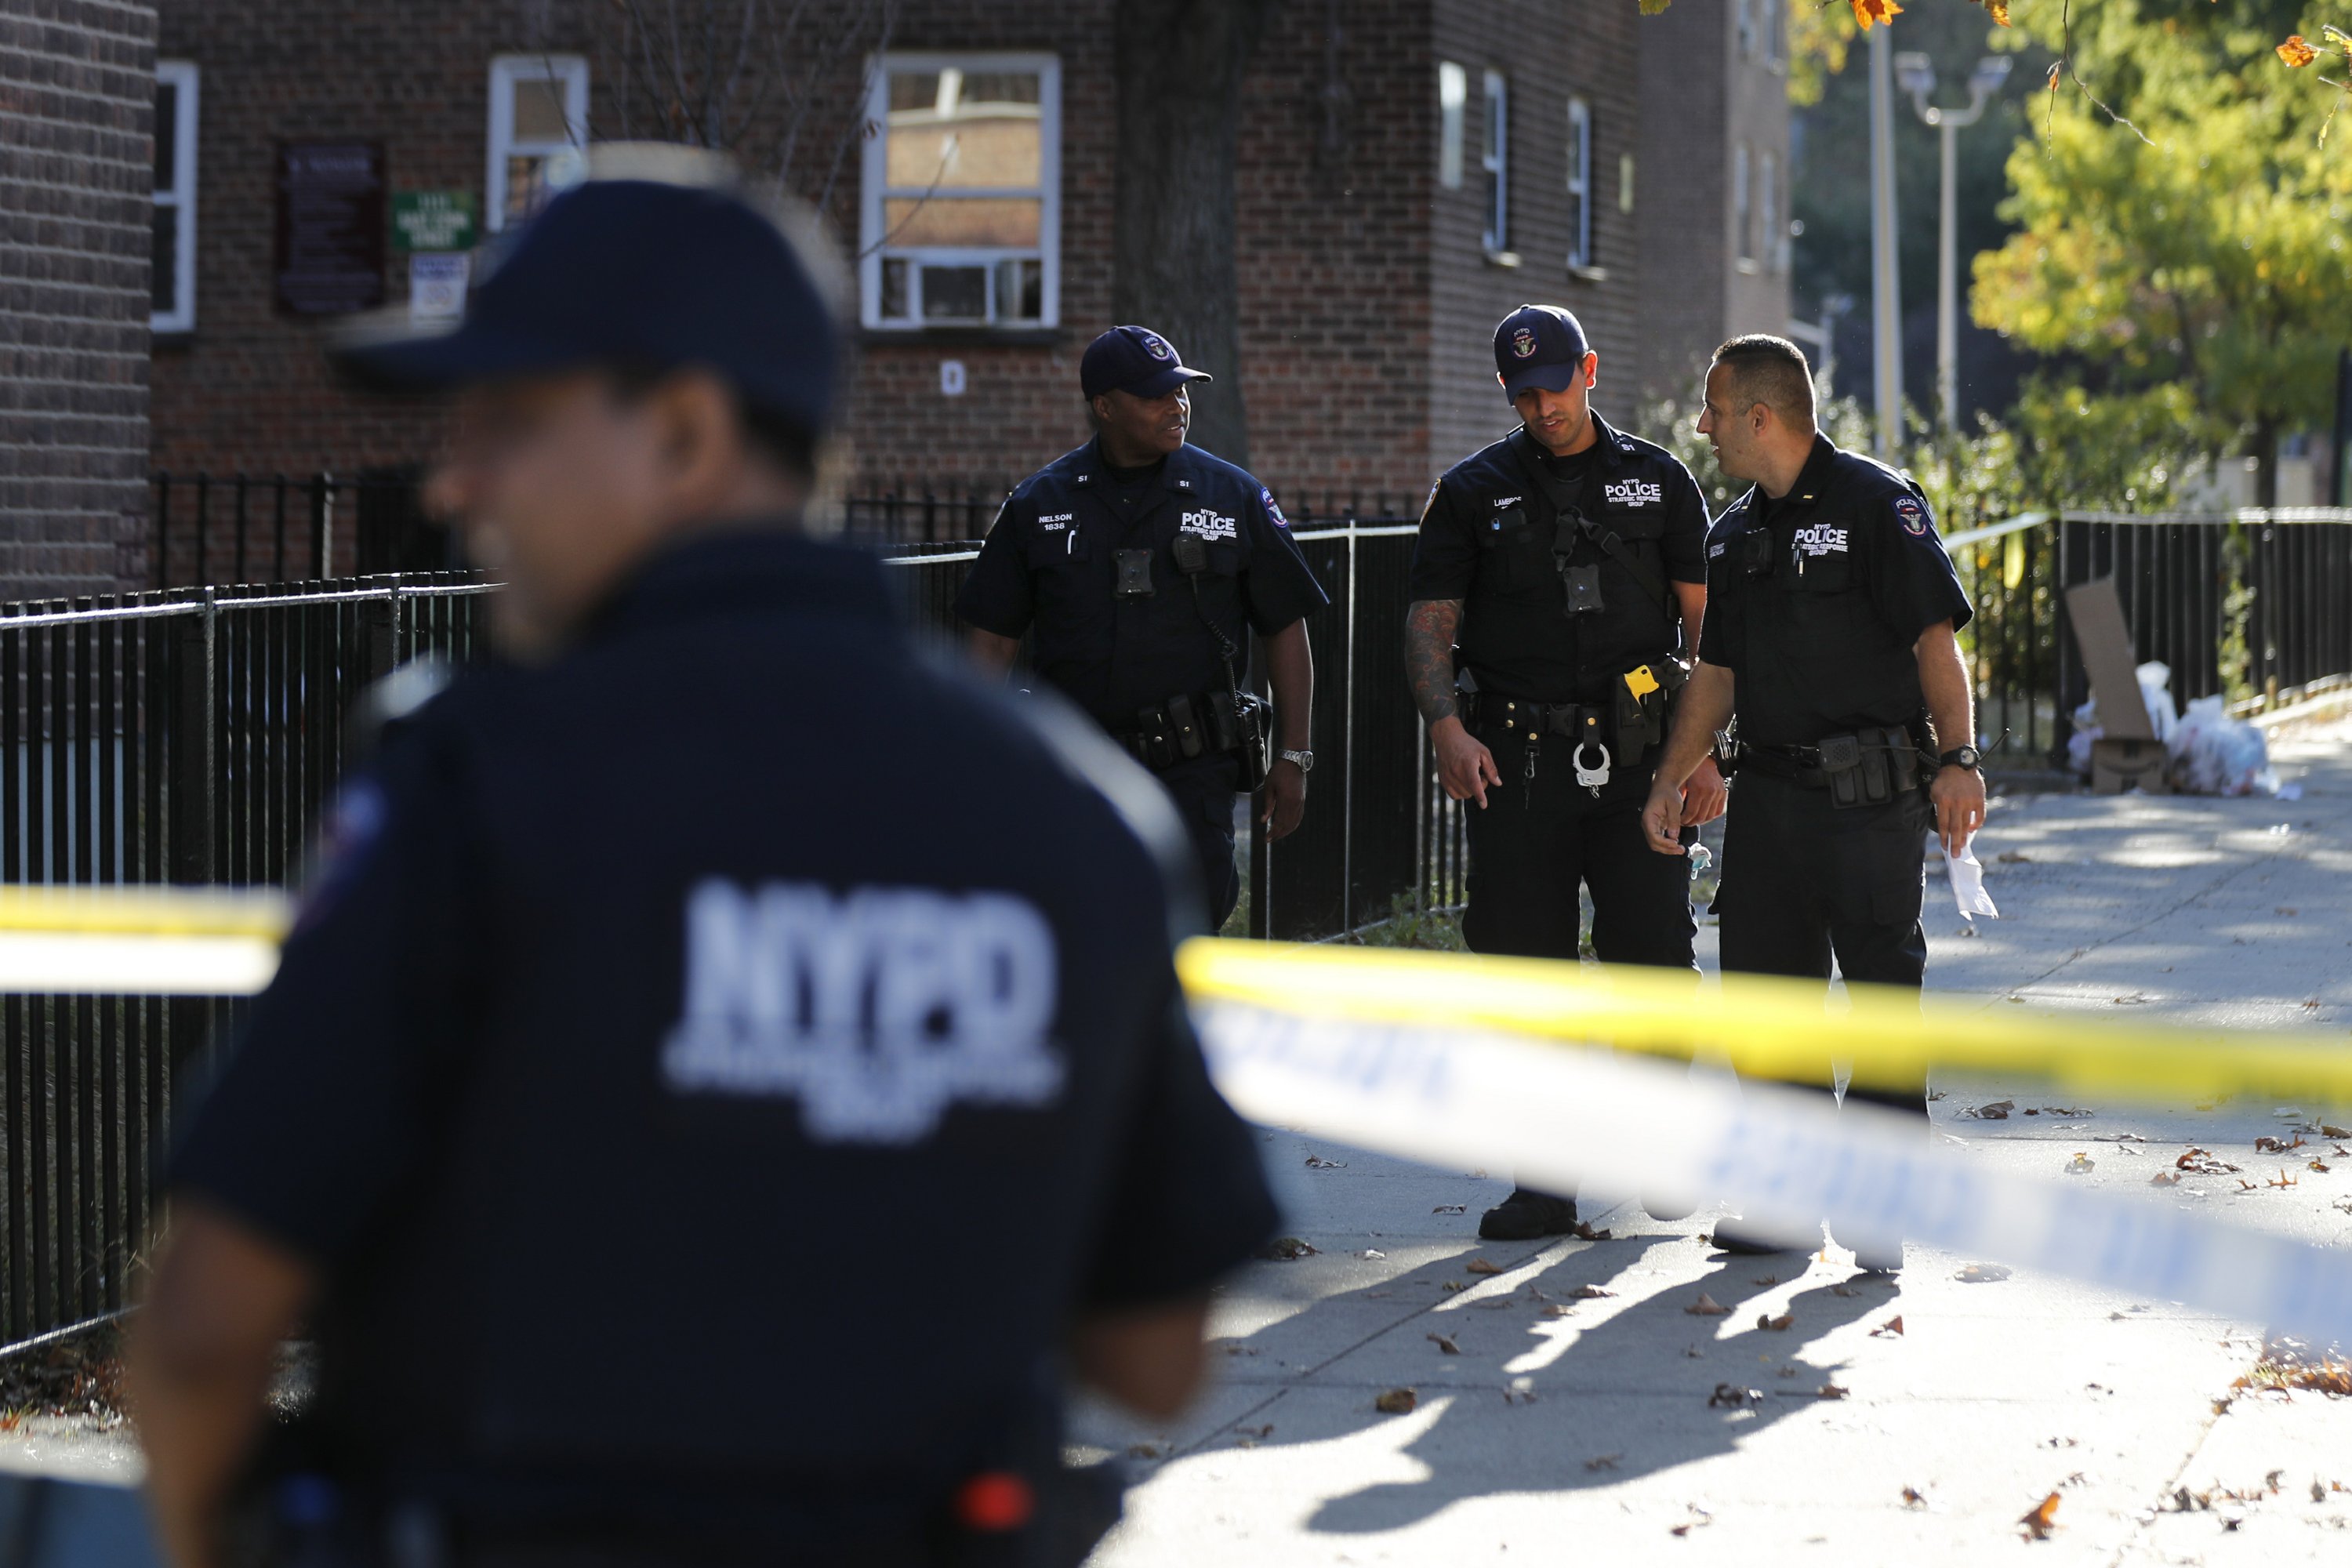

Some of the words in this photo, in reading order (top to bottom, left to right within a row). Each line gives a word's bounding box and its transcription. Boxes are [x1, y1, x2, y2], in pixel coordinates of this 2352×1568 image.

[1605, 484, 1661, 497] POLICE
[1200, 508, 1218, 517] NYPD
[1039, 514, 1072, 524] NELSON
[1181, 512, 1236, 531] POLICE
[1044, 522, 1065, 531] 1838
[1180, 525, 1208, 535] STRATEGIC
[1794, 528, 1848, 545] POLICE
[1820, 543, 1848, 552] RESPONSE
[686, 876, 1058, 1048] NYPD
